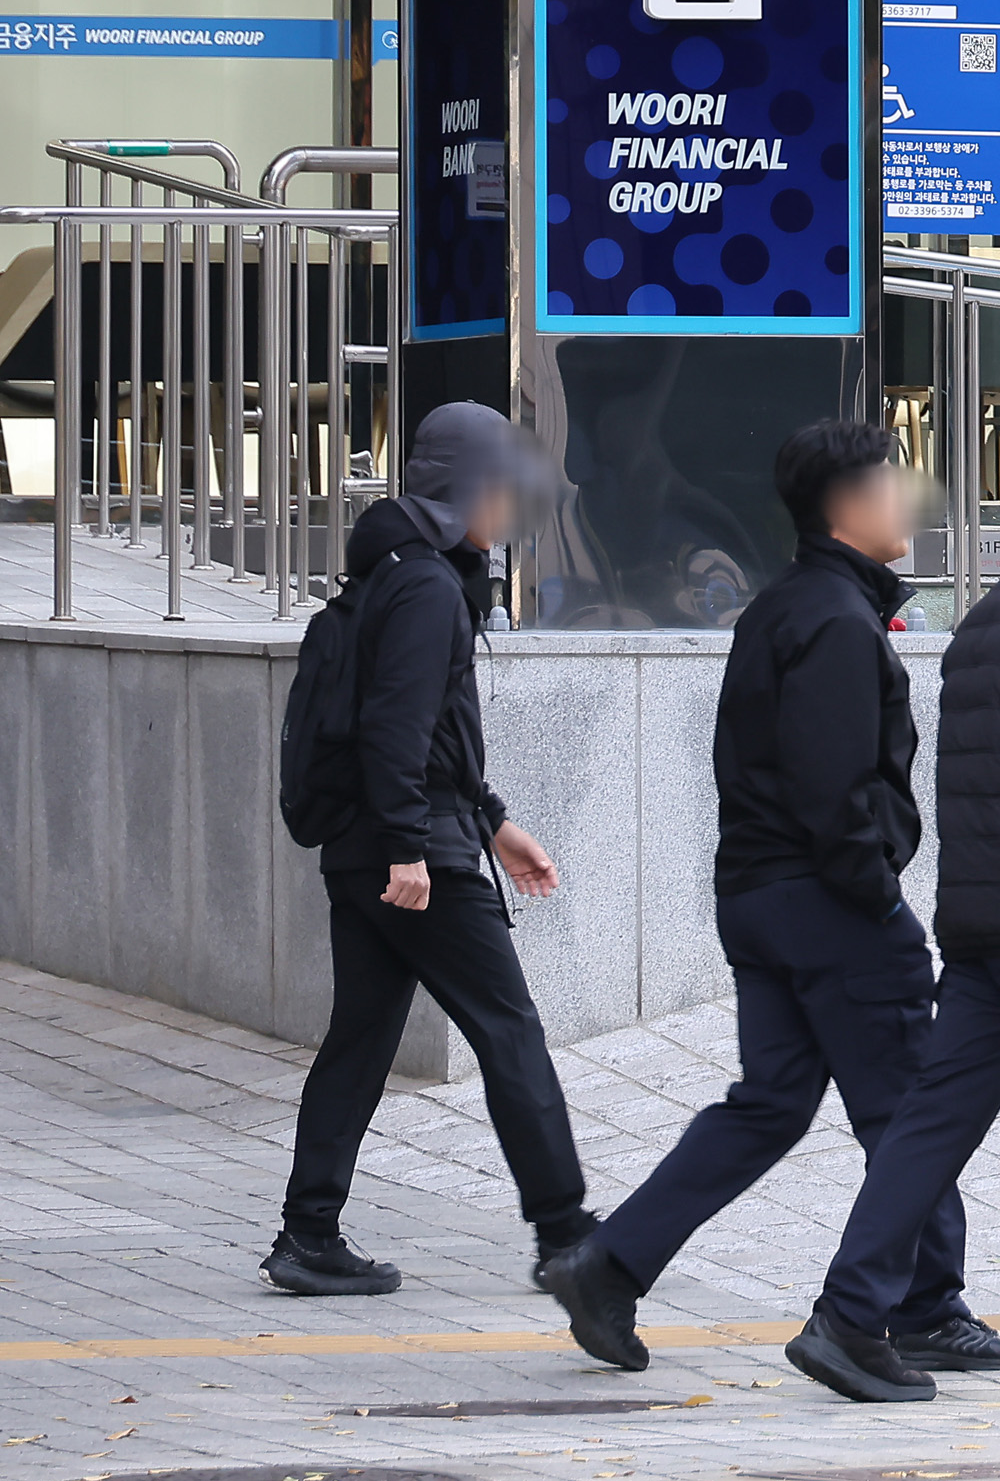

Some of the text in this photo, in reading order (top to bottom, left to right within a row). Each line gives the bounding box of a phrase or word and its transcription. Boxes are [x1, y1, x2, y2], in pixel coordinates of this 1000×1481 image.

[0, 22, 265, 50] 금융지주 WOORI FINANCIAL GROUP
[441, 99, 480, 134] WOORI
[608, 92, 728, 126] WOORI
[442, 143, 477, 177] BANK
[608, 137, 788, 170] FINANCIAL
[892, 154, 930, 165] 있습니다.
[924, 142, 951, 153] 보행상
[915, 167, 961, 178] 부과합니다.
[608, 181, 723, 214] GROUP
[898, 205, 964, 216] 02-3396-5374
